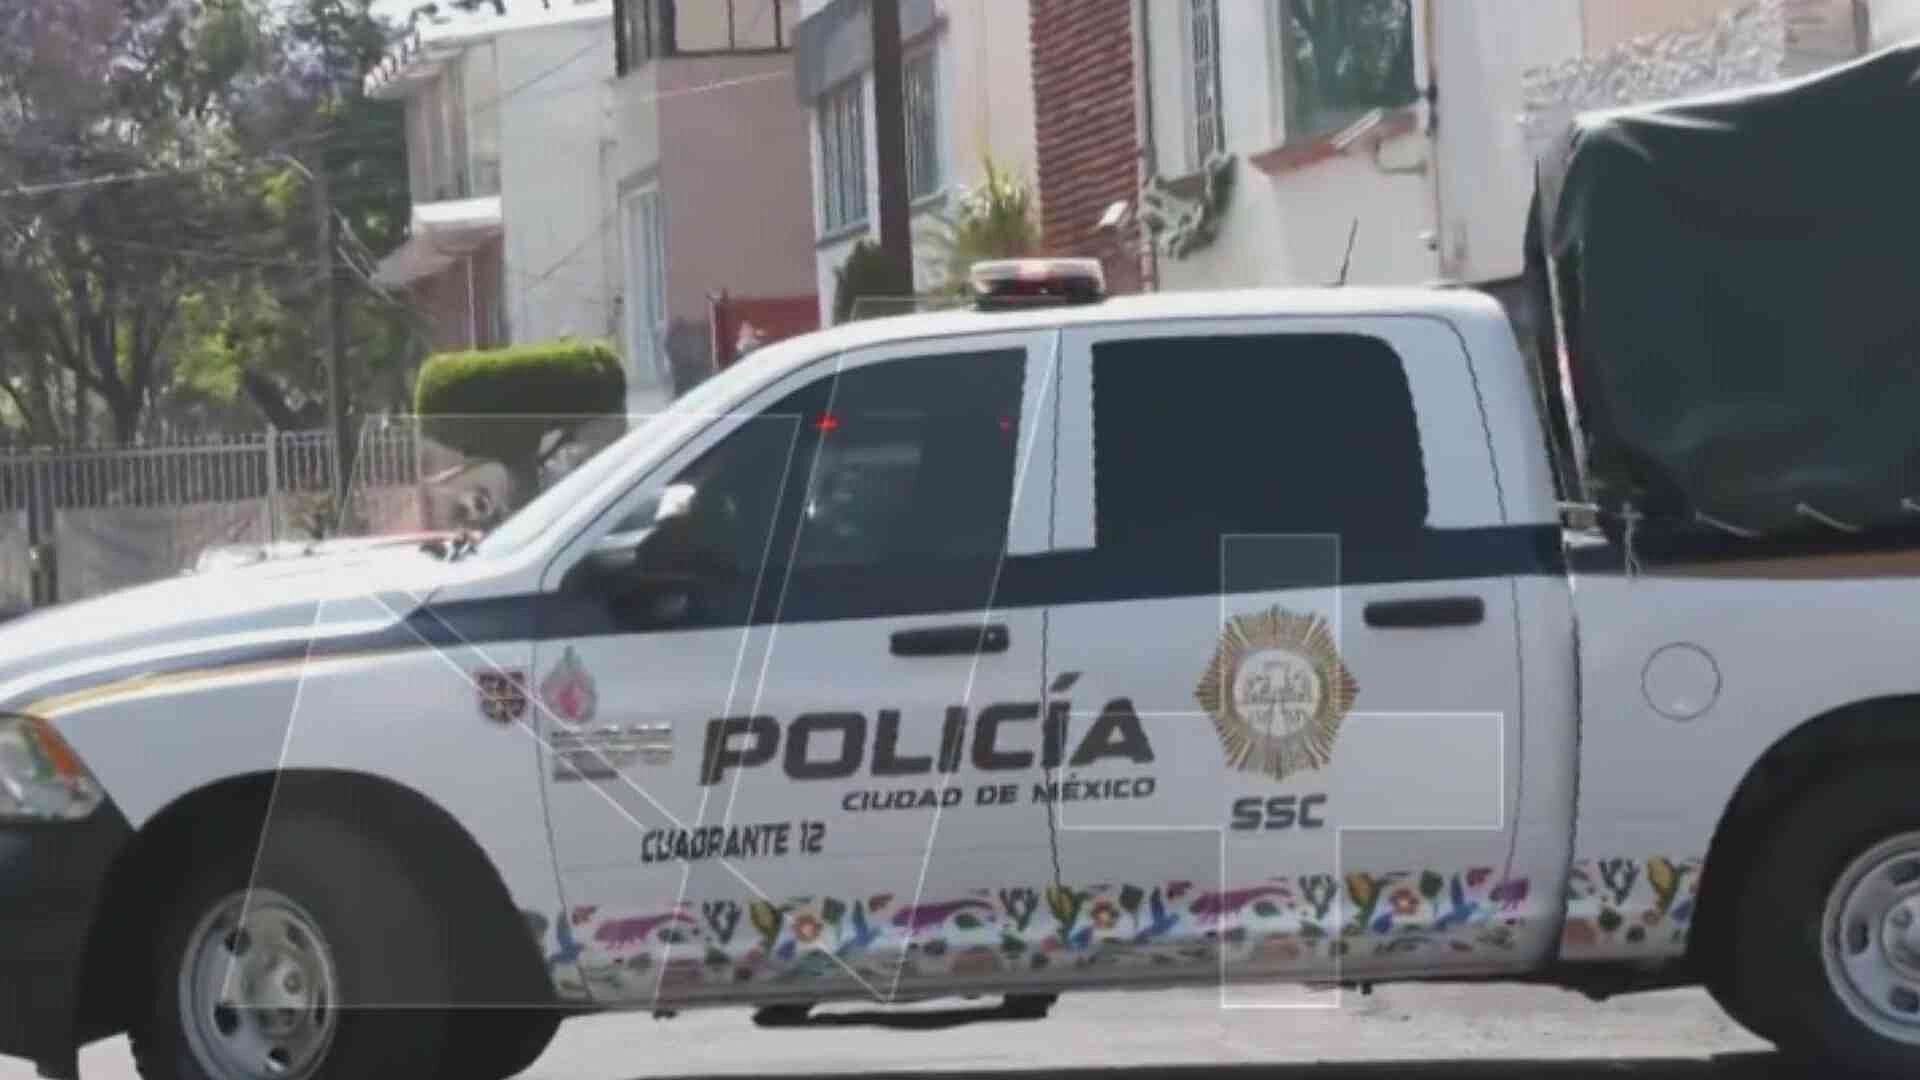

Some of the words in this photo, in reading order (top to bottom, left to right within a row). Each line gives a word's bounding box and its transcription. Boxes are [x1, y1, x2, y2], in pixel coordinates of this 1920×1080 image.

[699, 671, 1156, 785] POLICÍA
[841, 786, 963, 812] CIUDAD
[974, 783, 1020, 806] DE
[1031, 771, 1156, 804] MÉXICO
[1229, 793, 1328, 831] SSC
[640, 821, 792, 864] CUADRANTE
[799, 819, 826, 856] 12
